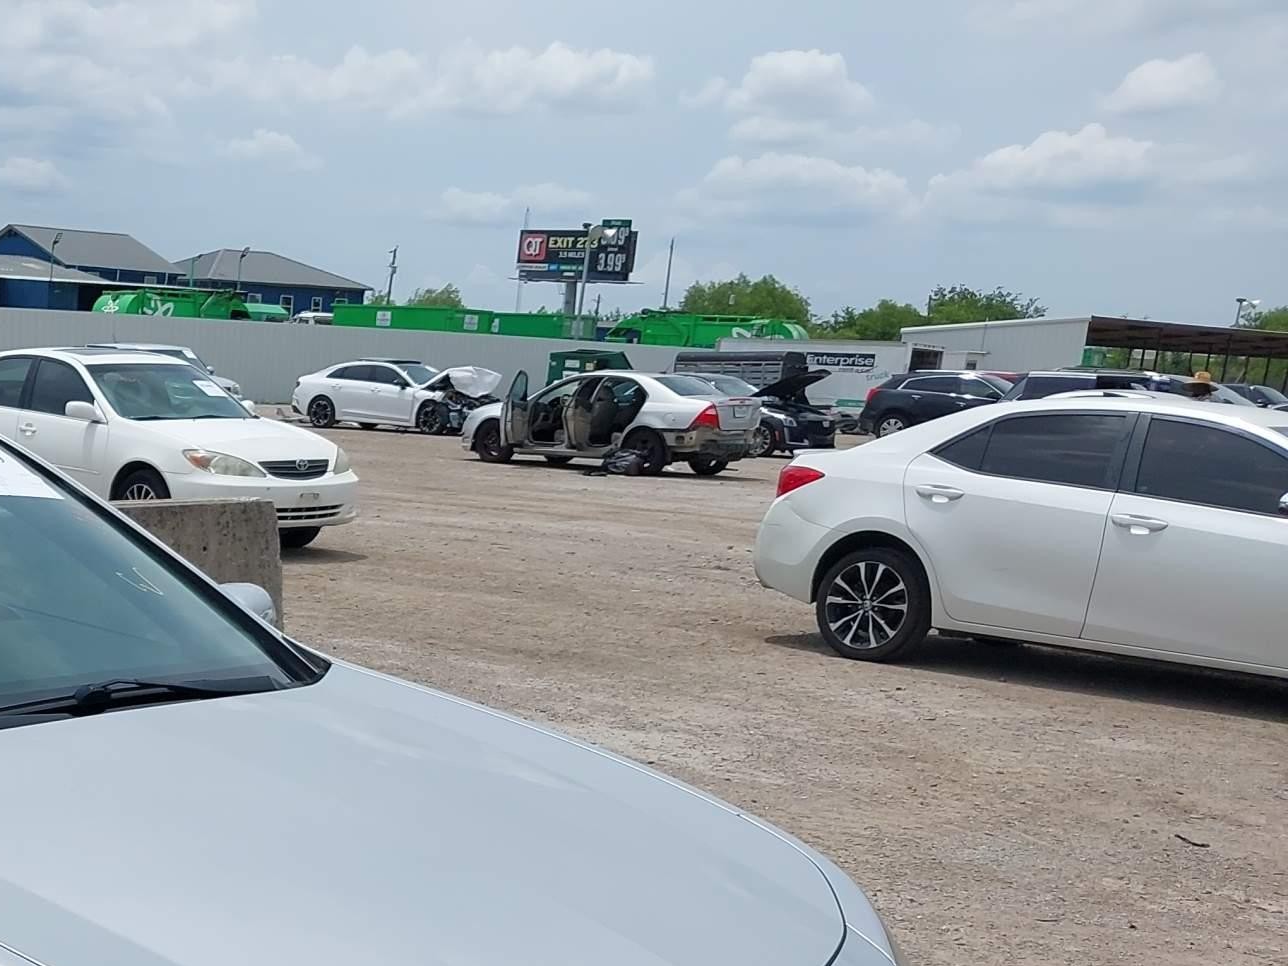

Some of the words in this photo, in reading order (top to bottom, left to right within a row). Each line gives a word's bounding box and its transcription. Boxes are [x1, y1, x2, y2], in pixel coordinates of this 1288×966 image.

[524, 237, 543, 256] QT
[549, 237, 574, 248] EXIT
[807, 354, 874, 366] Enterprise
